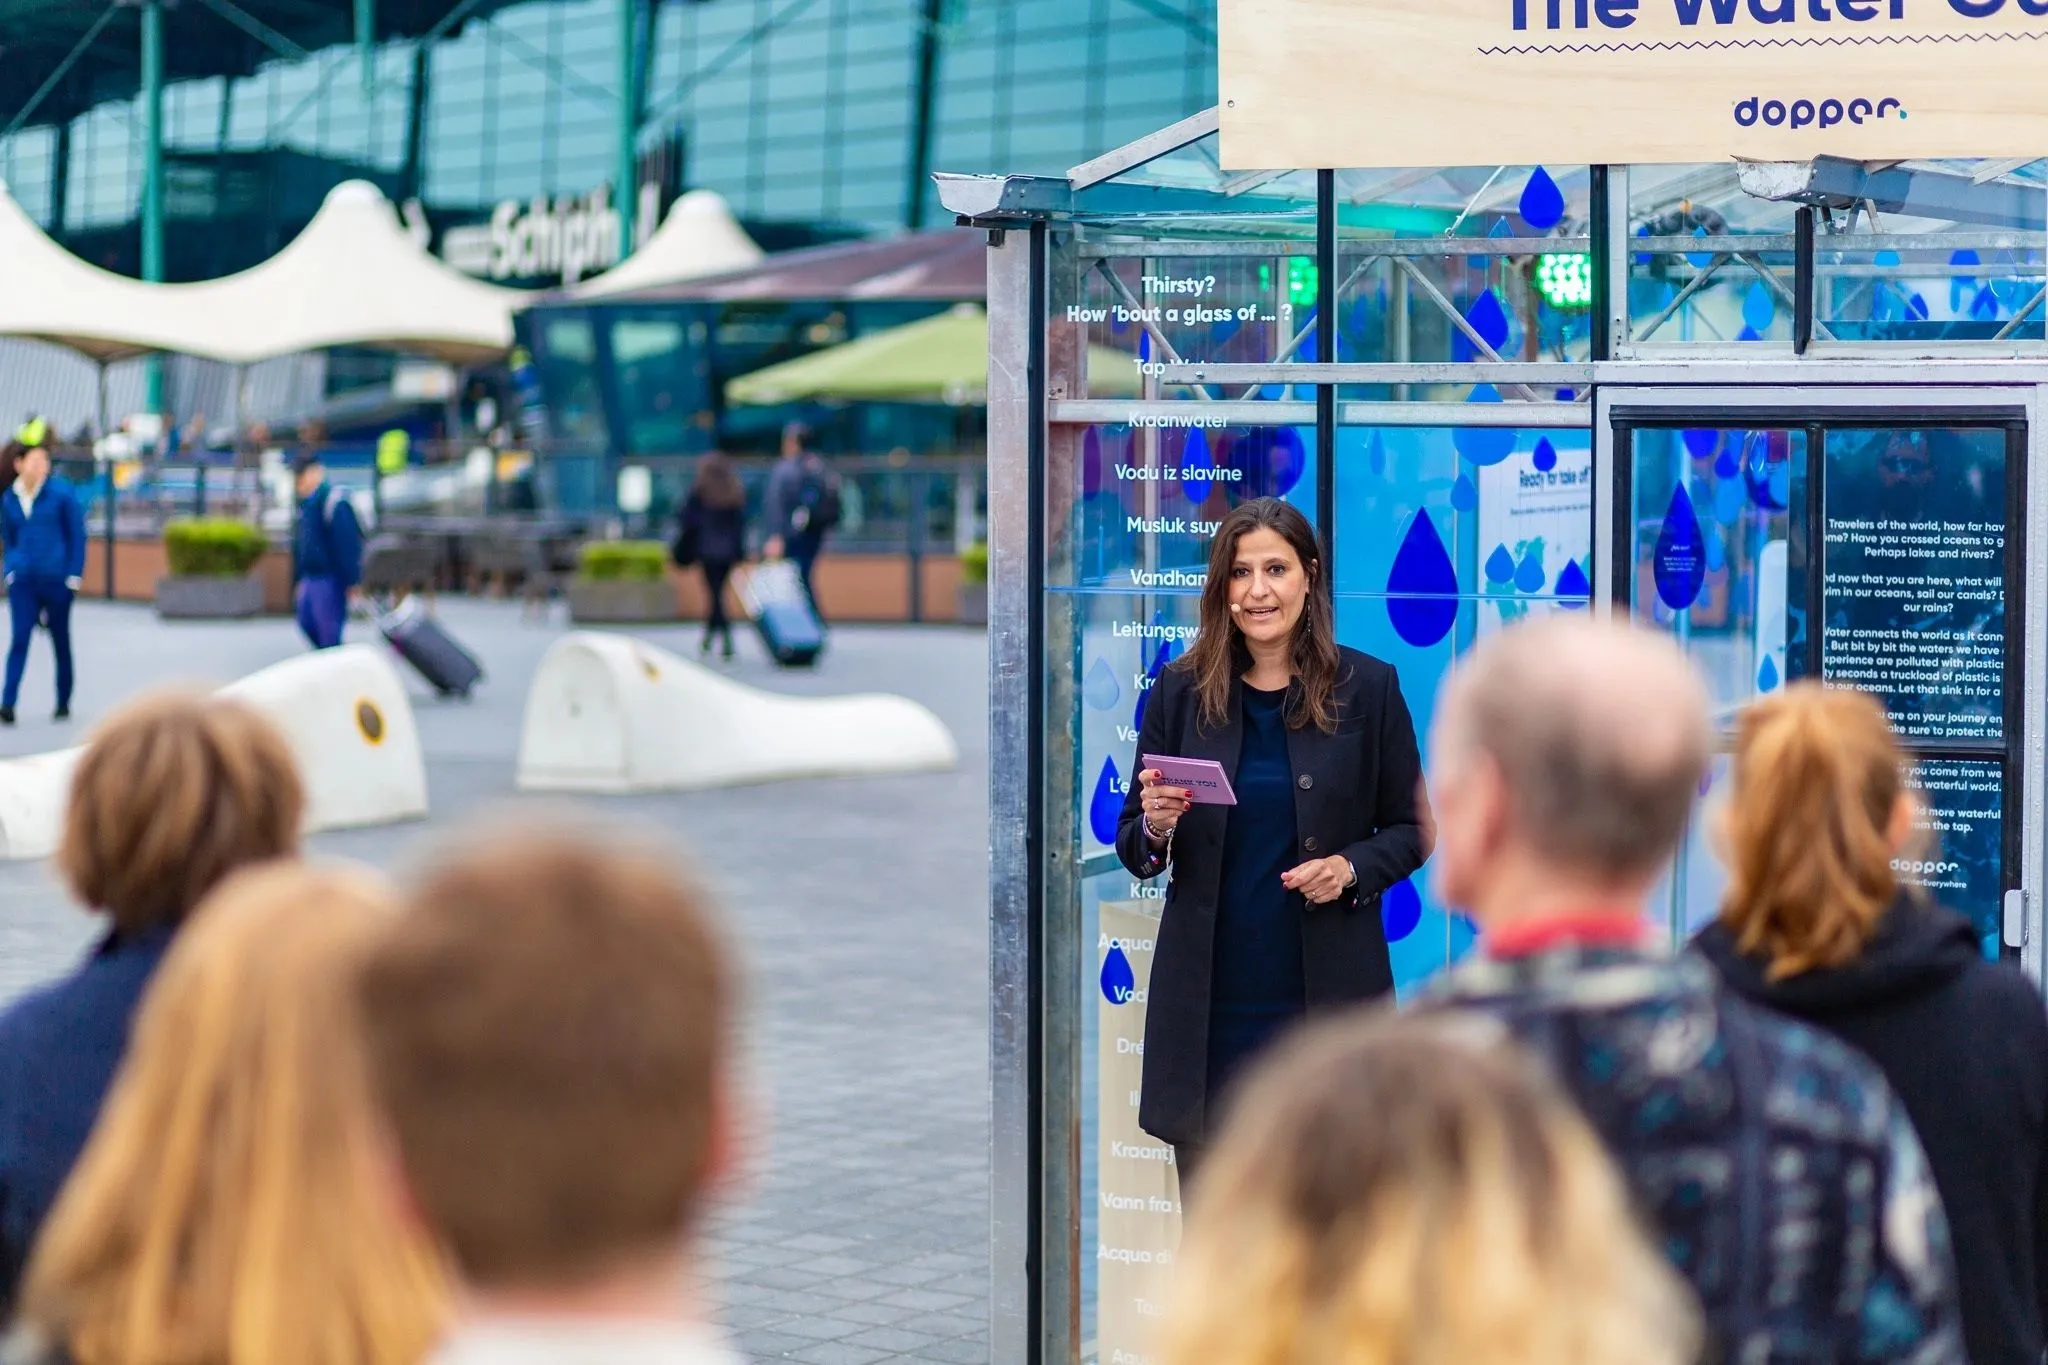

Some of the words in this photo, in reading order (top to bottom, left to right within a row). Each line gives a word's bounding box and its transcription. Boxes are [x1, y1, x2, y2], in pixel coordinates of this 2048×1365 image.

[1142, 276, 1215, 297] Thirsty?
[1066, 305, 1107, 323] How
[1165, 309, 1178, 322] a
[1183, 304, 1232, 326] glass
[1237, 304, 1257, 322] of
[1134, 359, 1166, 379] Tap
[1128, 412, 1229, 428] Kraanwater
[1115, 464, 1159, 481] Vodu
[1163, 464, 1177, 481] iz
[1181, 464, 1243, 481] slavine
[1127, 516, 1186, 533] Musluk
[1190, 520, 1224, 537] suy
[1829, 519, 1874, 530] Travelers
[1877, 519, 1887, 530] of
[1889, 520, 1907, 531] the
[1909, 520, 1941, 532] world,
[1943, 521, 1966, 532] how
[1967, 521, 1983, 532] far
[1851, 533, 1877, 543] Have
[1879, 535, 1899, 545] you
[1901, 534, 1941, 545] crossed
[1943, 536, 1981, 545] oceans
[1983, 536, 1994, 546] to
[1864, 547, 1907, 559] Perhaps
[1908, 548, 1936, 558] lakes
[1938, 548, 1959, 559] and
[1960, 549, 1995, 559] rivers?
[1838, 574, 1859, 584] now
[1862, 573, 1884, 584] that
[1886, 576, 1905, 586] you
[1907, 576, 1925, 585] are
[1926, 576, 1953, 587] here,
[1955, 576, 1982, 586] what
[1984, 577, 2002, 587] will
[1843, 587, 1853, 597] in
[1854, 589, 1872, 598] our
[1874, 589, 1915, 599] oceans,
[1916, 589, 1935, 599] sail
[1937, 591, 1955, 600] our
[1956, 590, 1997, 601] canals?
[1903, 603, 1921, 612] our
[1923, 603, 1954, 613] rains?
[1112, 621, 1204, 641] Leitungsw
[1852, 628, 1900, 639] connects
[1901, 629, 1919, 639] the
[1921, 630, 1950, 641] world
[1952, 632, 1966, 641] as
[1967, 631, 1976, 641] it
[1831, 641, 1849, 651] But
[1850, 641, 1865, 652] bit
[1867, 641, 1881, 654] by
[1882, 642, 1897, 652] bit
[1899, 642, 1917, 653] the
[1918, 644, 1954, 654] waters
[1956, 645, 1971, 655] we
[1973, 645, 2000, 655] have
[1876, 657, 1894, 666] are
[1895, 656, 1939, 669] polluted
[1941, 657, 1964, 668] with
[1836, 669, 1878, 680] seconds
[1880, 671, 1888, 680] a
[1890, 670, 1940, 682] truckload
[1942, 671, 1953, 681] of
[1955, 672, 1990, 683] plastic
[1992, 673, 2001, 683] is
[1836, 682, 1854, 691] our
[1856, 683, 1896, 693] oceans.
[1898, 683, 1915, 694] Let
[1916, 684, 1939, 695] that
[1941, 685, 1962, 696] sink
[1964, 685, 1974, 696] in
[1976, 686, 1991, 697] for
[1993, 688, 2001, 697] a
[1887, 711, 1905, 721] are
[1907, 712, 1921, 721] on
[1922, 713, 1946, 724] your
[1947, 712, 1987, 725] journey
[1116, 725, 1140, 742] Ve
[1887, 723, 1906, 734] ake
[1908, 726, 1930, 735] sure
[1932, 726, 1944, 736] to
[1946, 727, 1984, 738] protect
[1908, 768, 1928, 777] you
[1929, 767, 1959, 777] come
[1960, 767, 1985, 778] from
[1904, 779, 1923, 789] this
[1924, 780, 1968, 791] waterful
[1969, 781, 2002, 792] world.
[1928, 808, 1955, 818] more
[1957, 809, 2002, 819] waterful
[1932, 820, 1951, 831] the
[1952, 822, 1974, 834] tap.
[1097, 932, 1153, 954] Acqua
[1100, 1192, 1144, 1211] Vann
[1148, 1195, 1172, 1213] fra
[1096, 1243, 1151, 1265] Acqua
